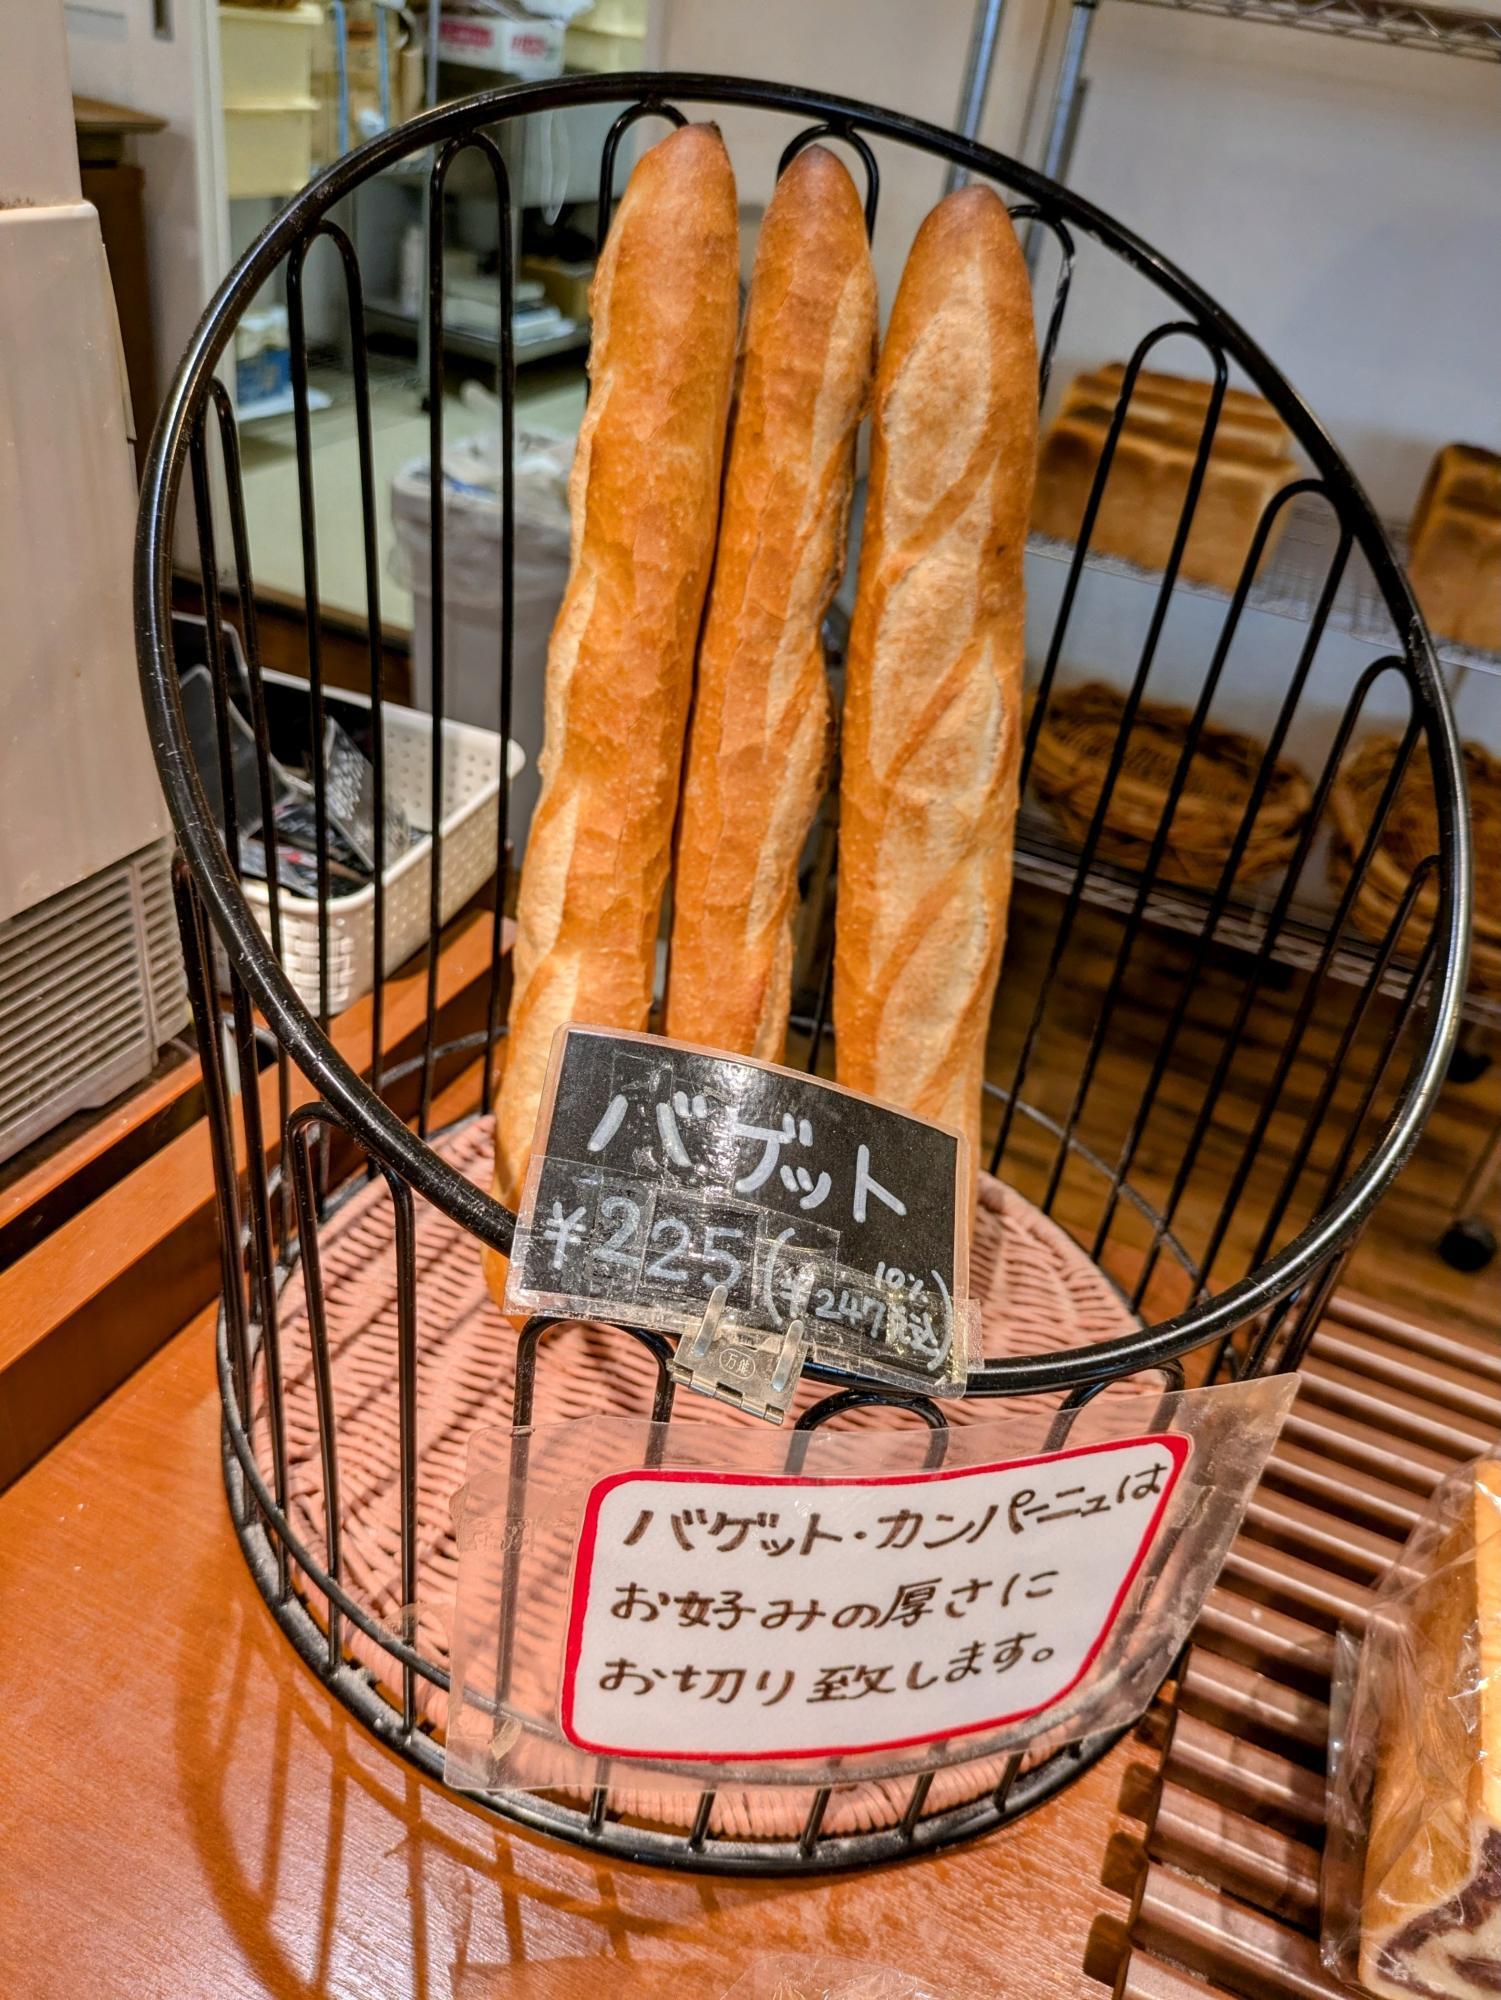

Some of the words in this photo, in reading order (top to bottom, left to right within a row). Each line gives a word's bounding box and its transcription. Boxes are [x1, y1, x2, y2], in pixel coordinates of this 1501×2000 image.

[587, 1091, 907, 1223] バゲット
[543, 1195, 744, 1289] ¥225
[622, 1461, 1168, 1557] バゲット・カンパーニュは
[610, 1570, 1060, 1630] お好みの厚さに
[598, 1632, 1056, 1706] お切り致します。
